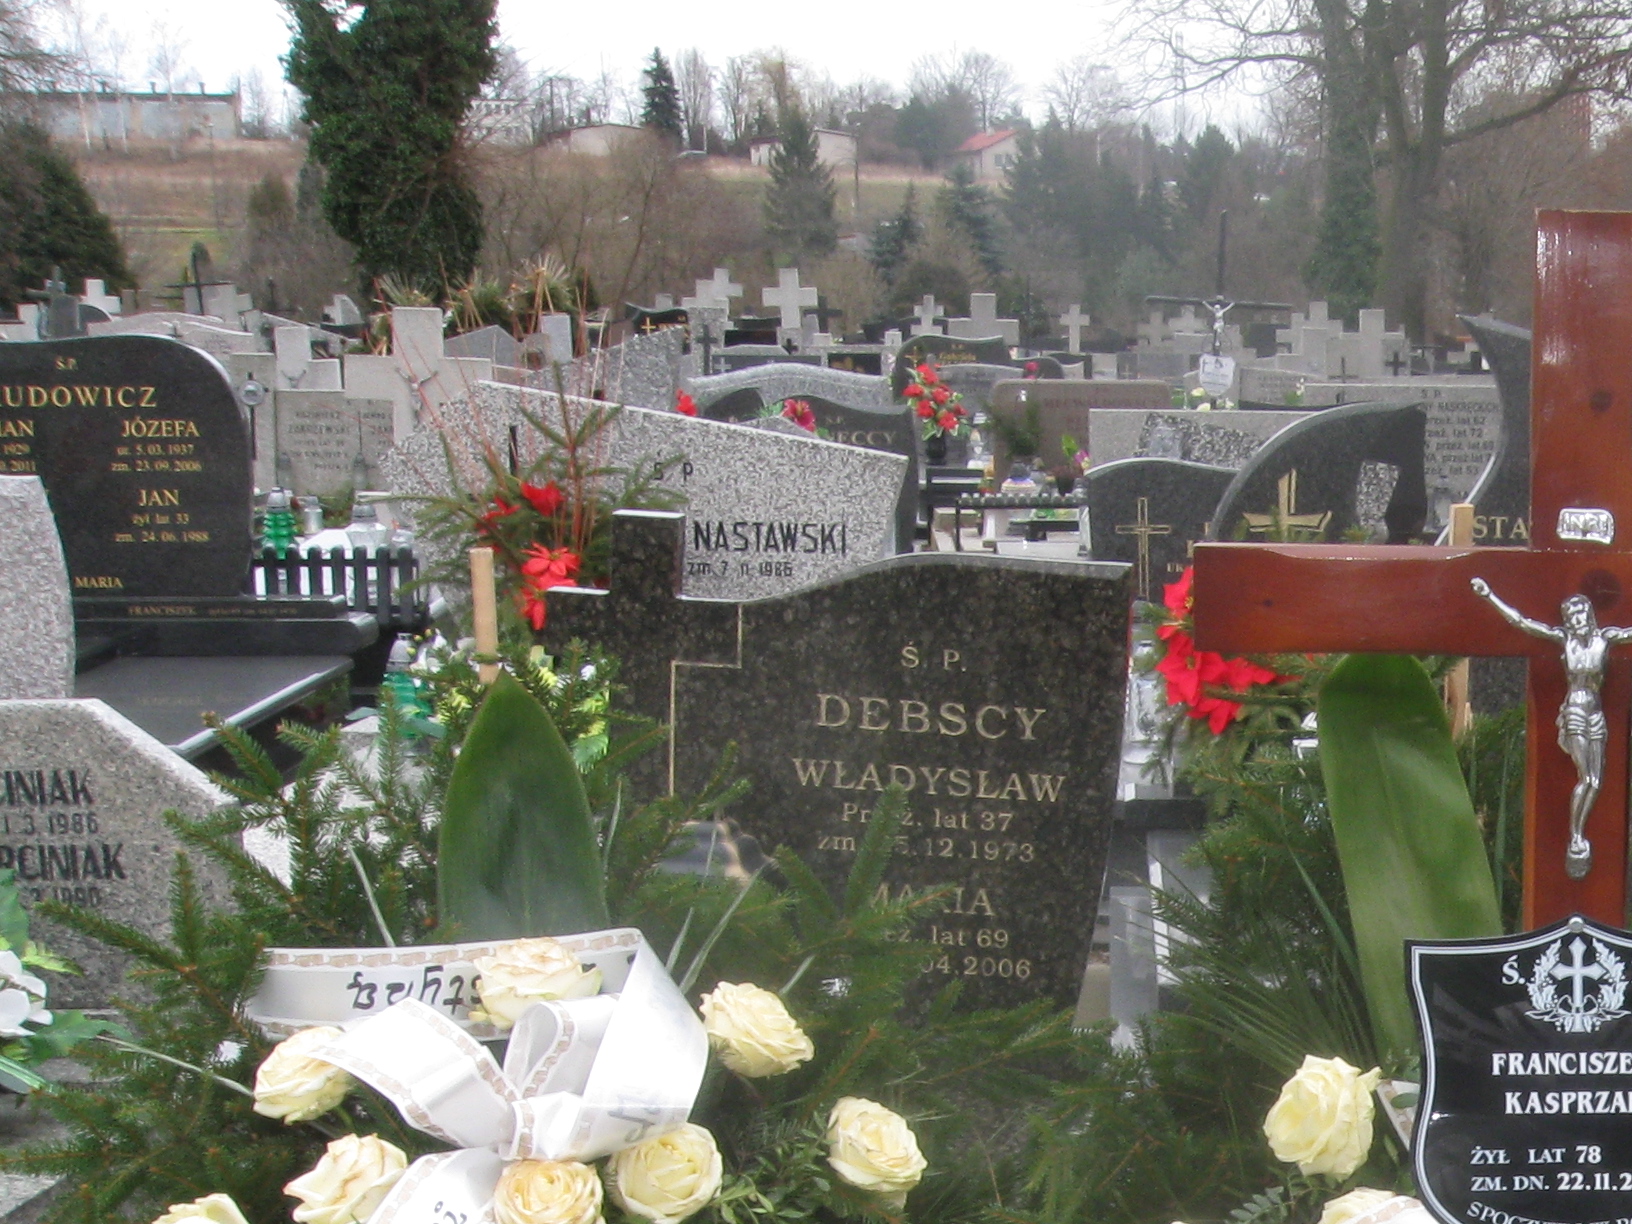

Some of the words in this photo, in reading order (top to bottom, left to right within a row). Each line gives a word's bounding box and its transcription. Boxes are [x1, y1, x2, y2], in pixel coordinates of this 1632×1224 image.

[0, 385, 157, 408] UDOWICZ
[122, 415, 200, 437] JÓZEFA
[138, 489, 180, 507] JAN
[693, 520, 847, 556] NASTAWSKI
[75, 576, 124, 589] MARIA
[0, 768, 95, 806] INIAK
[791, 757, 1067, 803] WŁADYSŁAW
[934, 807, 969, 830] lat
[980, 810, 1014, 832] 37
[890, 836, 1035, 863] 5.12.1973
[930, 925, 967, 948] lat
[975, 927, 1010, 949] 69
[1502, 954, 1526, 985] Ś.
[1470, 1145, 1511, 1165] ŻYŁ
[1527, 1148, 1566, 1165] LAT
[1576, 1145, 1602, 1164] 78
[1470, 1176, 1508, 1192] ZM.
[1512, 1175, 1550, 1192] DN.
